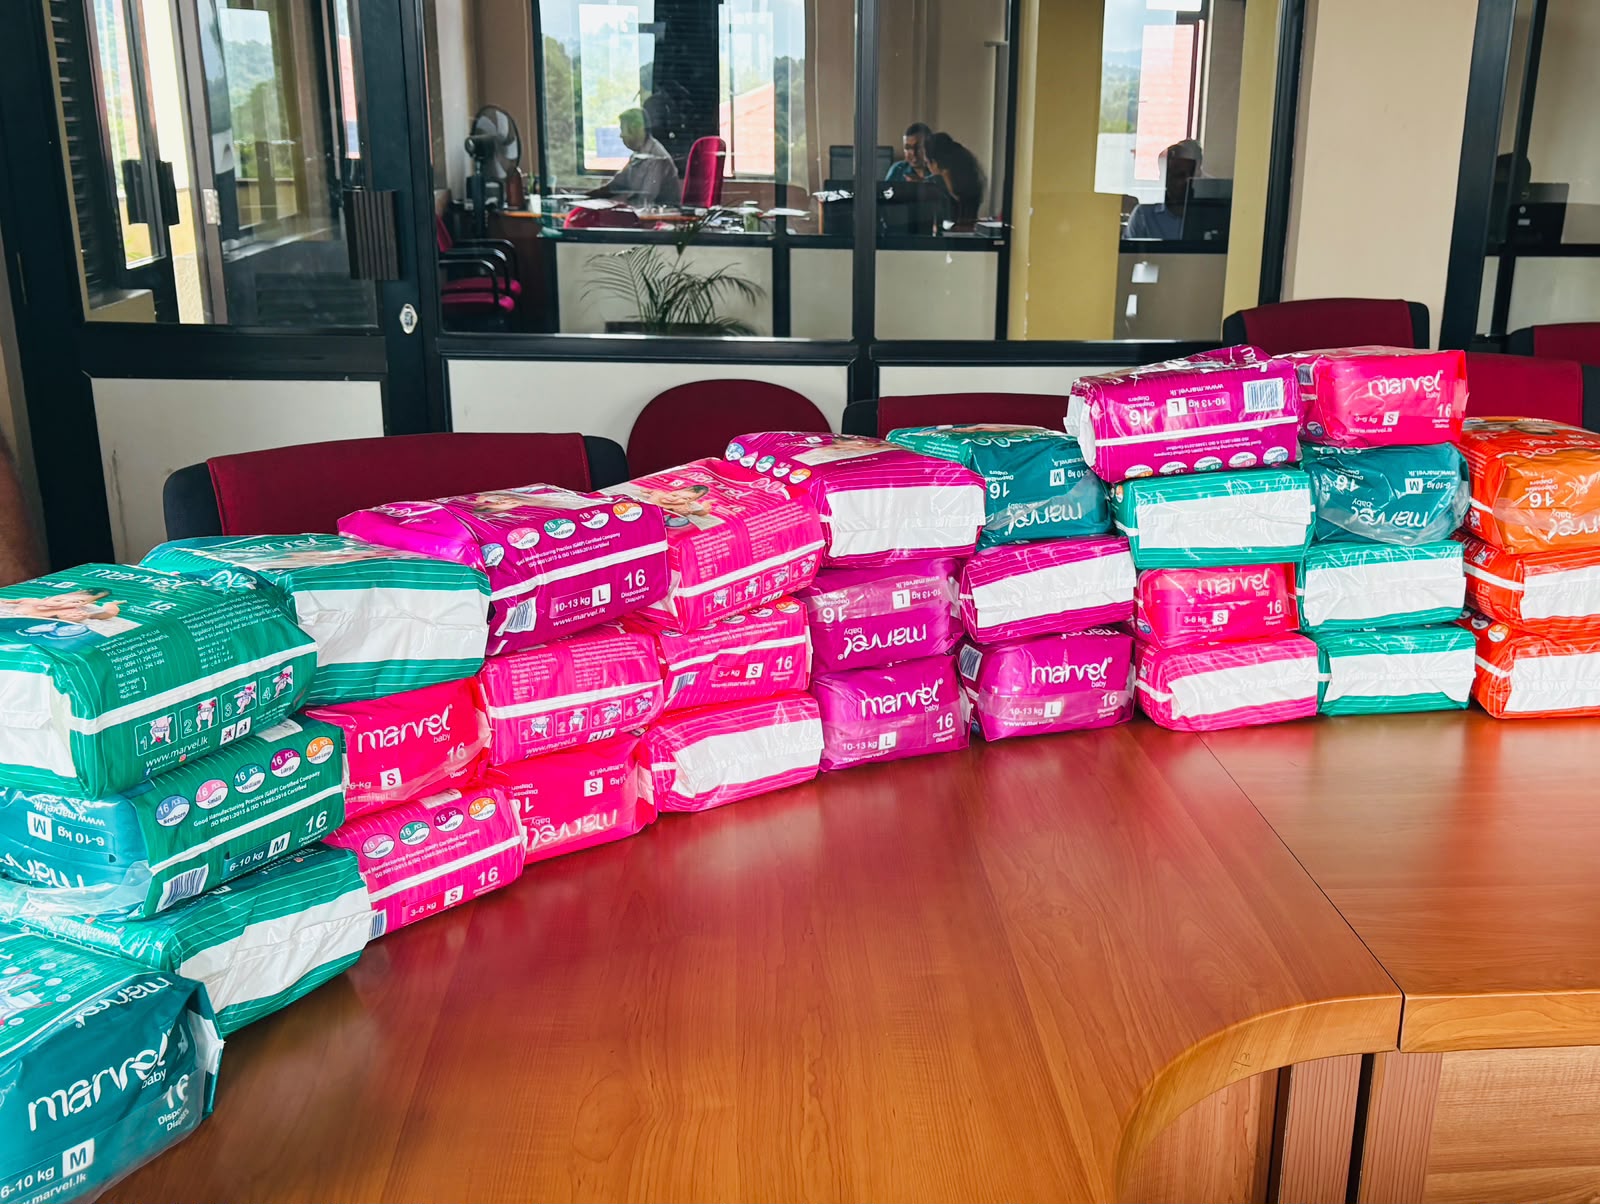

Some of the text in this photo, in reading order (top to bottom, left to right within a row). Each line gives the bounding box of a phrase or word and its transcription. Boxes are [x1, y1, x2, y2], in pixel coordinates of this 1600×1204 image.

[1368, 370, 1441, 396] marvel
[1173, 402, 1180, 411] L
[1201, 398, 1226, 408] 10-13
[1437, 403, 1452, 418] 16
[1129, 410, 1153, 426] 16
[1388, 414, 1394, 423] S
[1054, 472, 1061, 482] M
[989, 482, 1010, 499] 16
[1410, 482, 1419, 491] M
[1529, 491, 1555, 508] 16
[1008, 502, 1083, 534] marvel
[1351, 506, 1428, 528] marvel
[624, 569, 646, 590] 16
[1196, 568, 1270, 595] marvel
[599, 589, 607, 601] L
[621, 586, 649, 598] Disposable
[897, 594, 905, 604] L
[912, 591, 921, 600] kg
[553, 596, 591, 613] 10-13 kg
[1267, 600, 1282, 615] 16
[553, 607, 606, 627] www.marvel.lk
[822, 607, 847, 623] 16
[1217, 612, 1224, 622] S
[844, 627, 862, 635] baby
[843, 624, 927, 659] marvel
[751, 665, 758, 675] S
[775, 655, 793, 671] 16
[1031, 657, 1108, 684] marvel
[731, 668, 741, 677] kg
[1091, 680, 1107, 689] baby
[861, 679, 940, 717] marvel
[1101, 692, 1118, 707] 16
[924, 704, 939, 713] baby
[1033, 707, 1044, 716] kg
[1050, 704, 1056, 714] L
[357, 704, 451, 753] marvel
[936, 713, 953, 731] 16
[433, 734, 451, 744] baby
[842, 741, 877, 751] 10-13 kg
[885, 736, 891, 746] L
[145, 736, 208, 768] www.marvel.lk
[307, 743, 318, 753] 16
[447, 742, 466, 762] 16
[272, 751, 294, 767] 16 PCS
[235, 771, 246, 782] 16
[387, 772, 396, 785] S
[589, 781, 598, 792] S
[194, 816, 208, 827] Good
[209, 800, 244, 821] Manufacturing
[245, 793, 263, 806] Practice
[279, 779, 299, 791] Certified
[300, 771, 320, 783] Company
[210, 819, 219, 828] ISO
[250, 803, 259, 812] ISO
[287, 784, 307, 795] Certified
[158, 803, 170, 815] 16
[33, 817, 46, 835] M
[305, 810, 328, 834] 16
[436, 814, 447, 823] 16
[530, 817, 550, 826] baby
[57, 826, 105, 847] 6-10 kg
[530, 809, 618, 850] marvel
[272, 838, 286, 851] M
[229, 857, 250, 872] 6-10
[252, 852, 264, 861] kg
[477, 866, 498, 886] 16
[450, 890, 458, 900] S
[426, 902, 436, 910] kg
[27, 1031, 169, 1132] marvel
[69, 1147, 87, 1170] M
[1, 1167, 54, 1198] 6-10 kg
